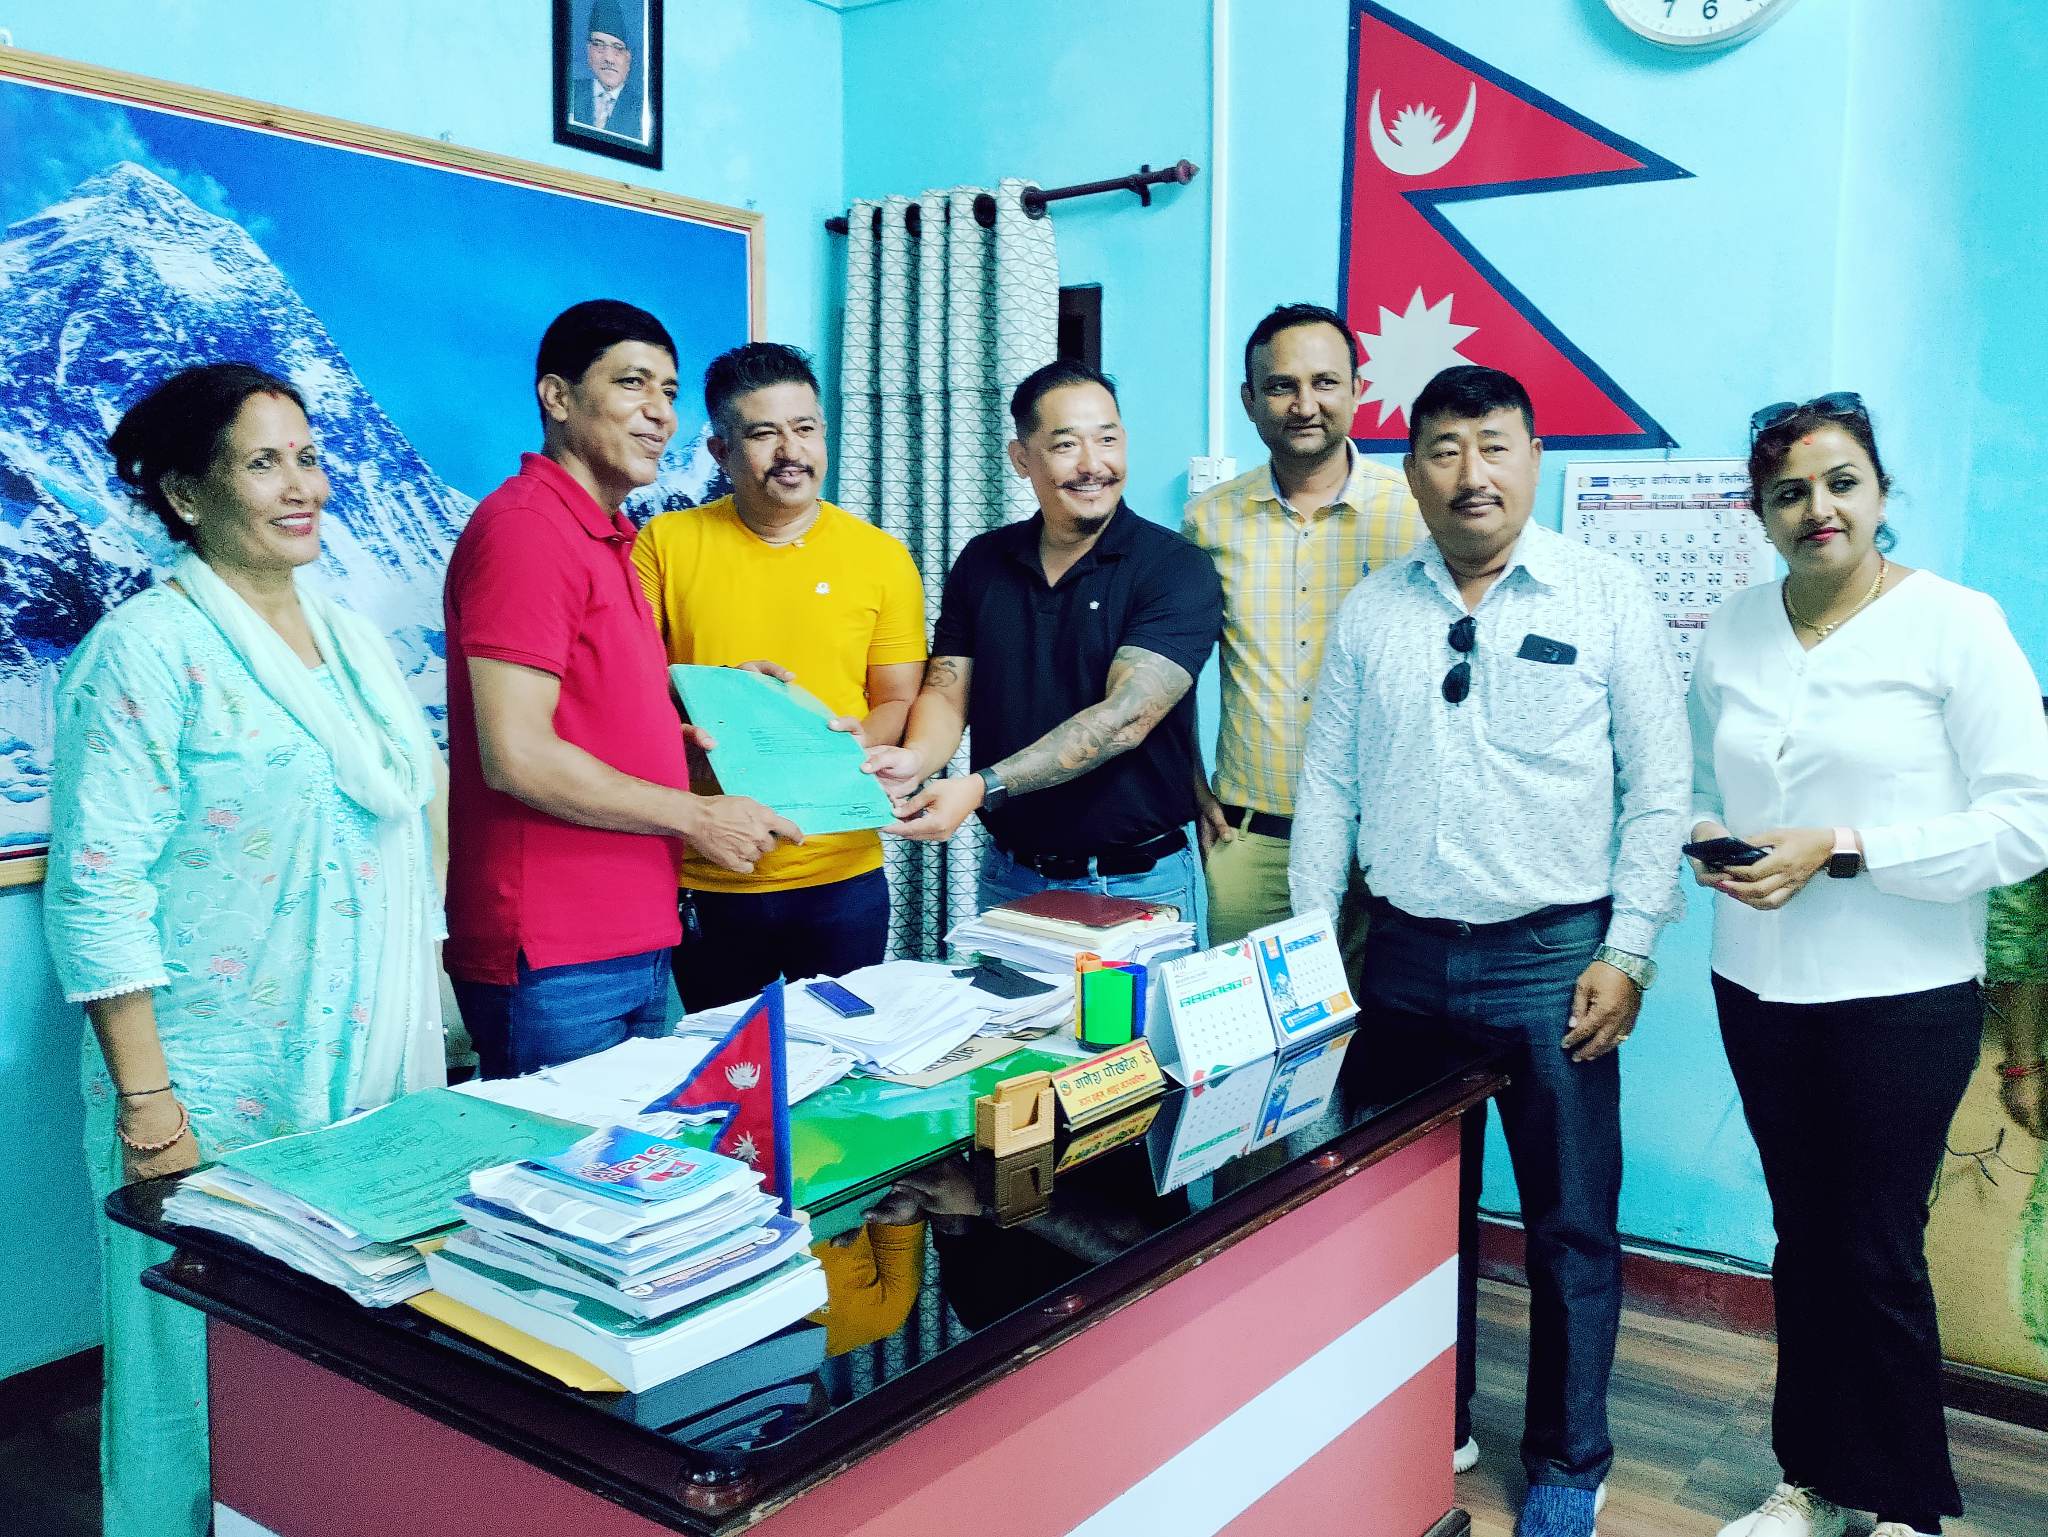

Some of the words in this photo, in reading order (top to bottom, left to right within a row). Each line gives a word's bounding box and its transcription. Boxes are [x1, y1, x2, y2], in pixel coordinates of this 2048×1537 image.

[1664, 0, 1676, 17] 7
[1703, 0, 1717, 19] 6
[1608, 533, 1617, 544] ४
[1680, 632, 1690, 643] ४
[1073, 1071, 1102, 1090] गणेश
[1103, 1056, 1139, 1077] पोखरेल
